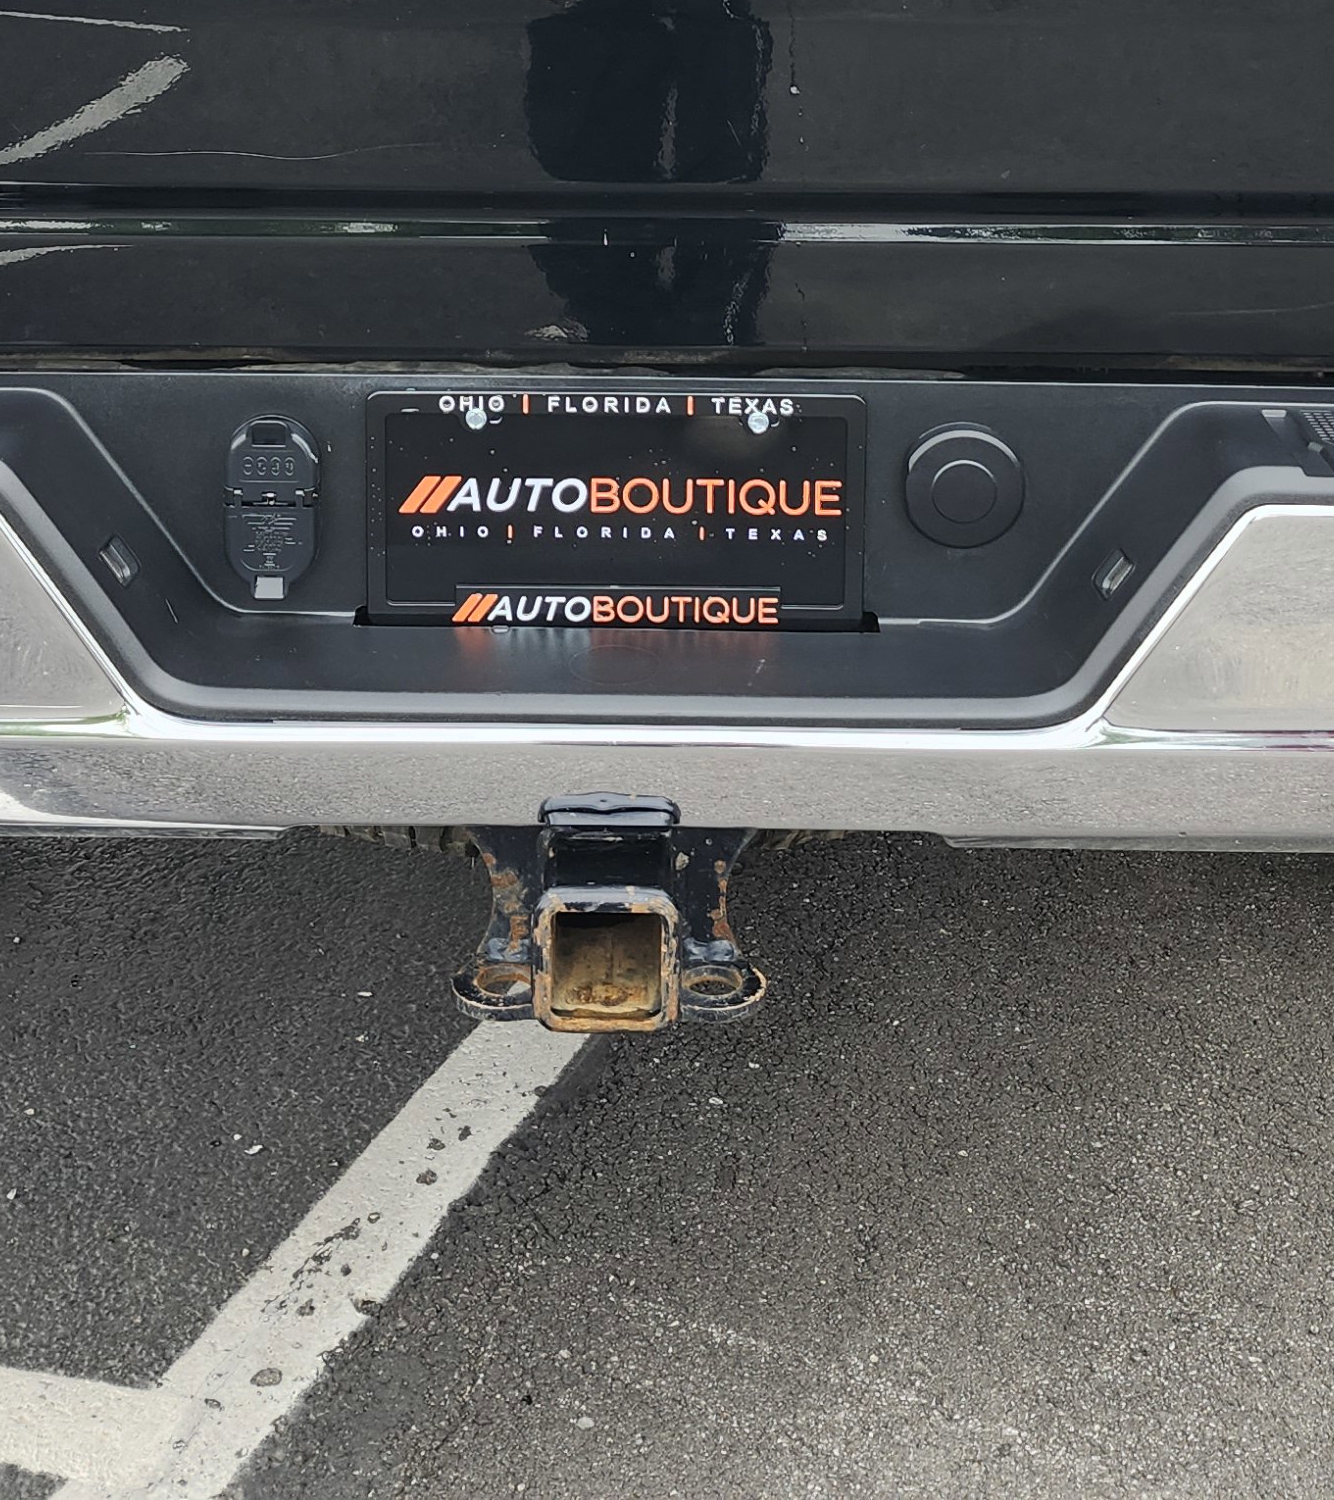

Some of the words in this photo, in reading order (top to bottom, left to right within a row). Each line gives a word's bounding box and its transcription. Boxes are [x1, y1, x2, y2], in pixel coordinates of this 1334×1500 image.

[438, 395, 505, 413] OHIO
[547, 396, 671, 414] FLORIDA
[711, 396, 794, 415] TEXAS
[446, 477, 843, 516] AUTOBOUTIQUE
[411, 525, 489, 538] OHIO
[533, 526, 675, 539] FLORIDA
[725, 528, 827, 541] TEXAS
[488, 596, 779, 623] AUTOBOUTIQUE
